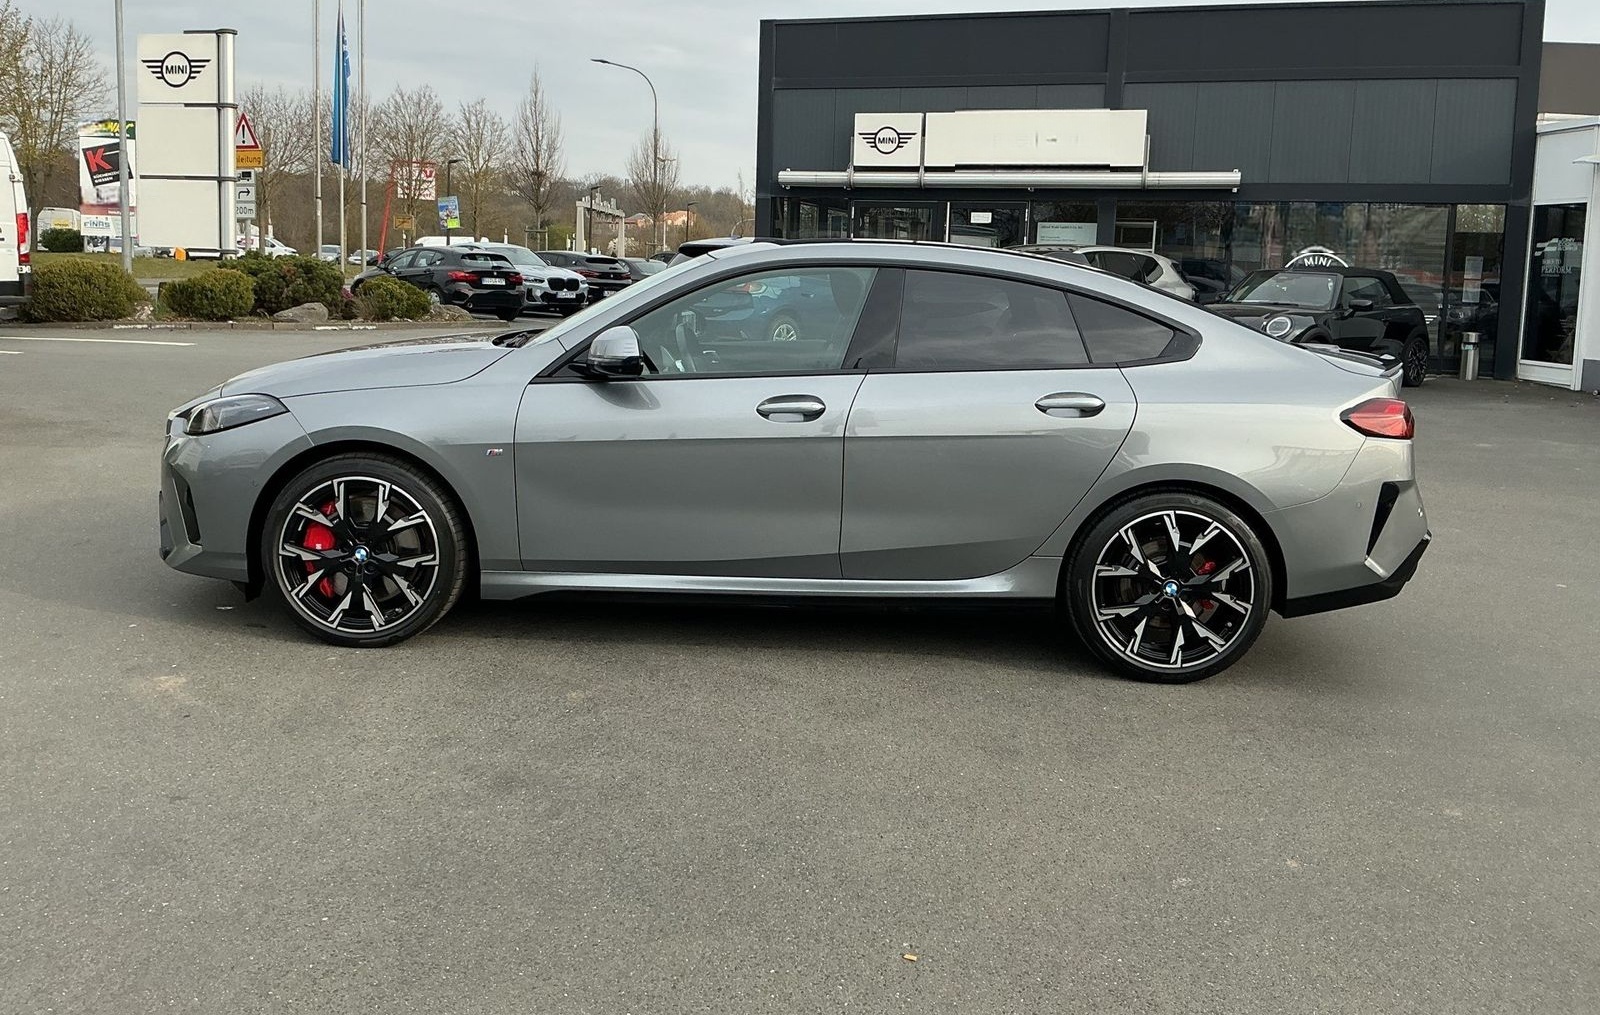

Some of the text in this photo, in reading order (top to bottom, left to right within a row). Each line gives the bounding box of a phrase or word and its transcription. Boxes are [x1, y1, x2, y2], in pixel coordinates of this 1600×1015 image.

[165, 65, 187, 74] MINI
[877, 136, 897, 144] MINI
[86, 147, 113, 172] K
[1304, 256, 1331, 267] MINI
